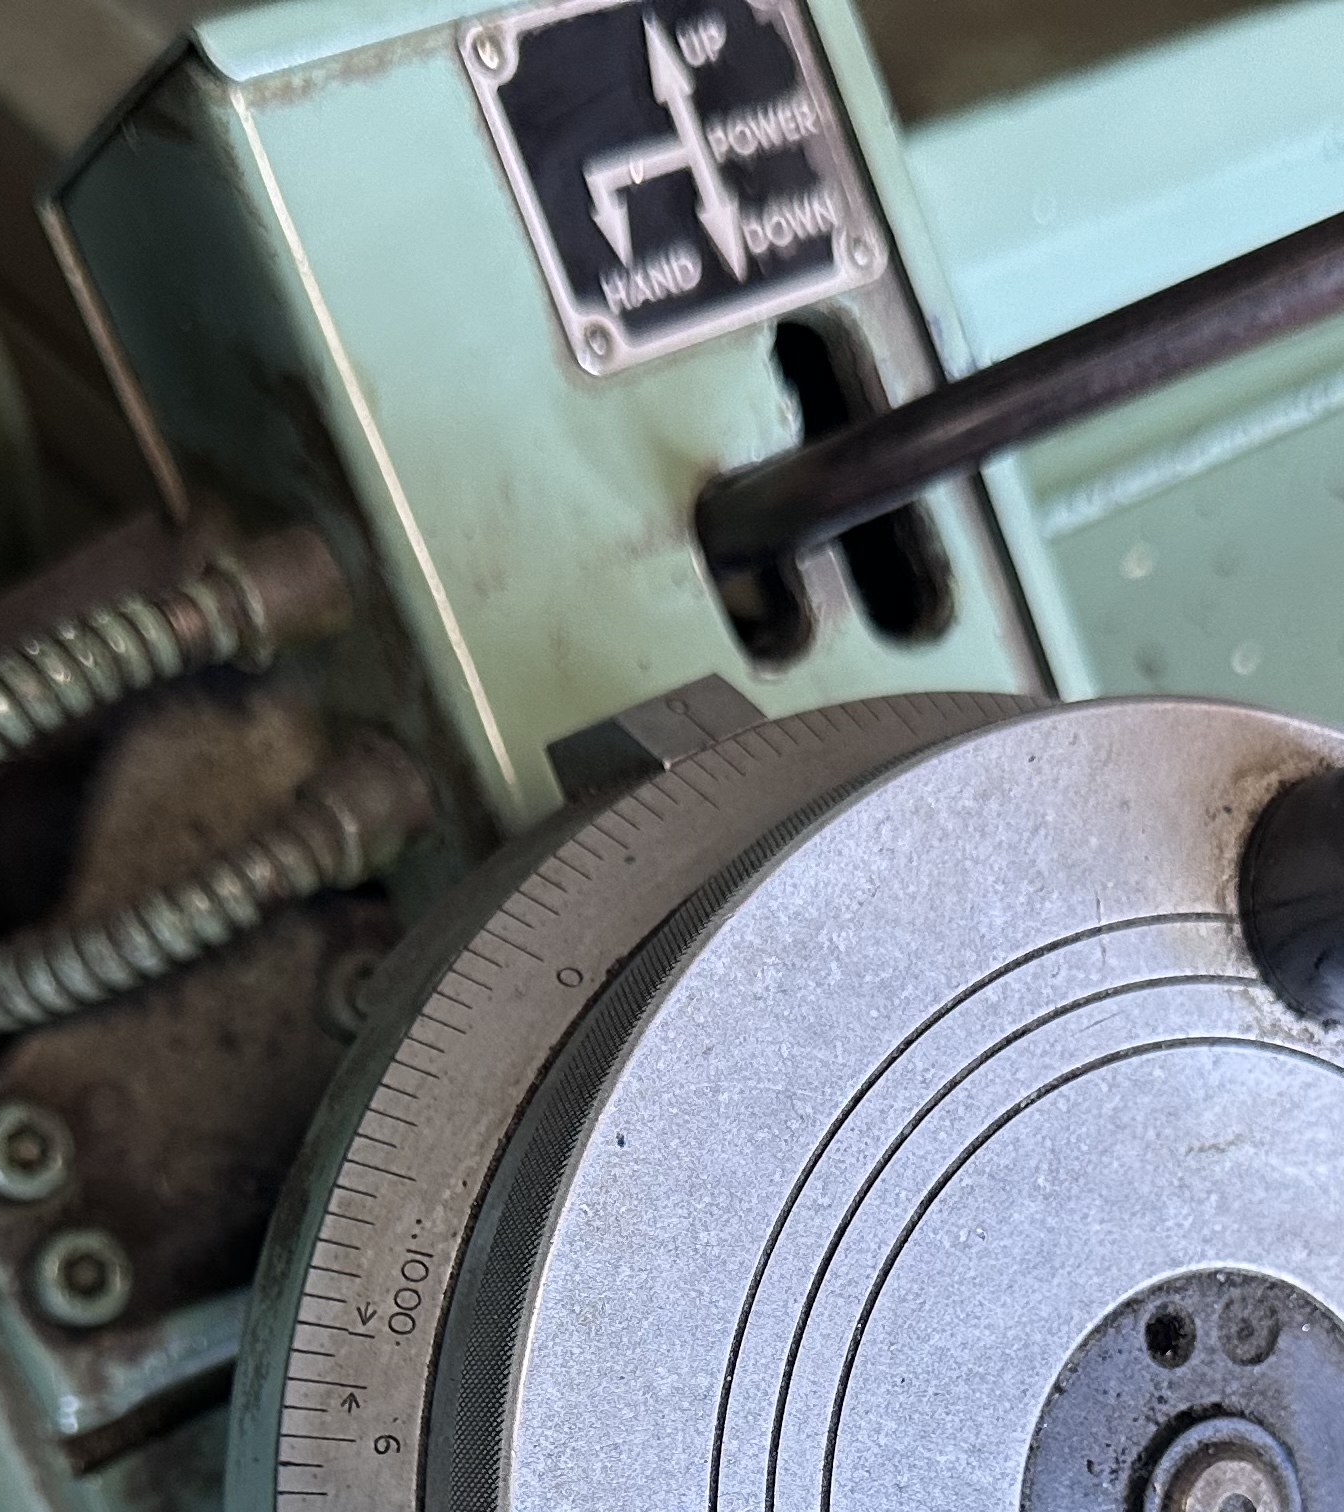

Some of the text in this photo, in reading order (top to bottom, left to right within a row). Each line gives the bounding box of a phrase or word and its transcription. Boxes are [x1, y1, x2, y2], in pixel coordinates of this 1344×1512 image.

[677, 17, 726, 66] UP
[708, 102, 816, 161] POWER
[744, 195, 838, 255] DOWN
[601, 250, 701, 314] HAND
[557, 966, 583, 988] 0
